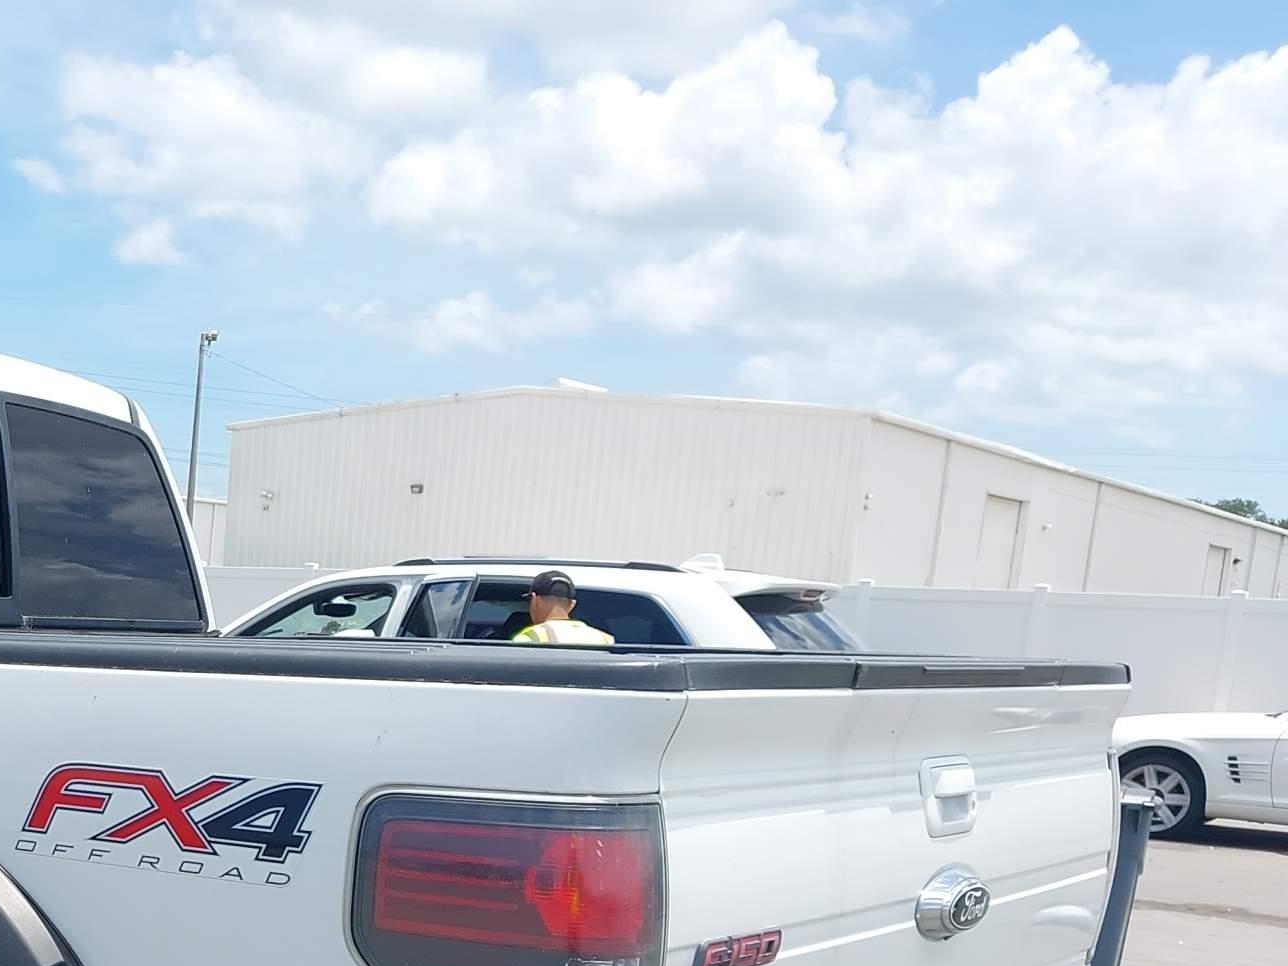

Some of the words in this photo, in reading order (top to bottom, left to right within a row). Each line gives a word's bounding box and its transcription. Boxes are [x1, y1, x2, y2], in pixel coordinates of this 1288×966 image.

[22, 763, 323, 864] FX4
[14, 839, 111, 861] OFF
[137, 855, 291, 885] ROAD
